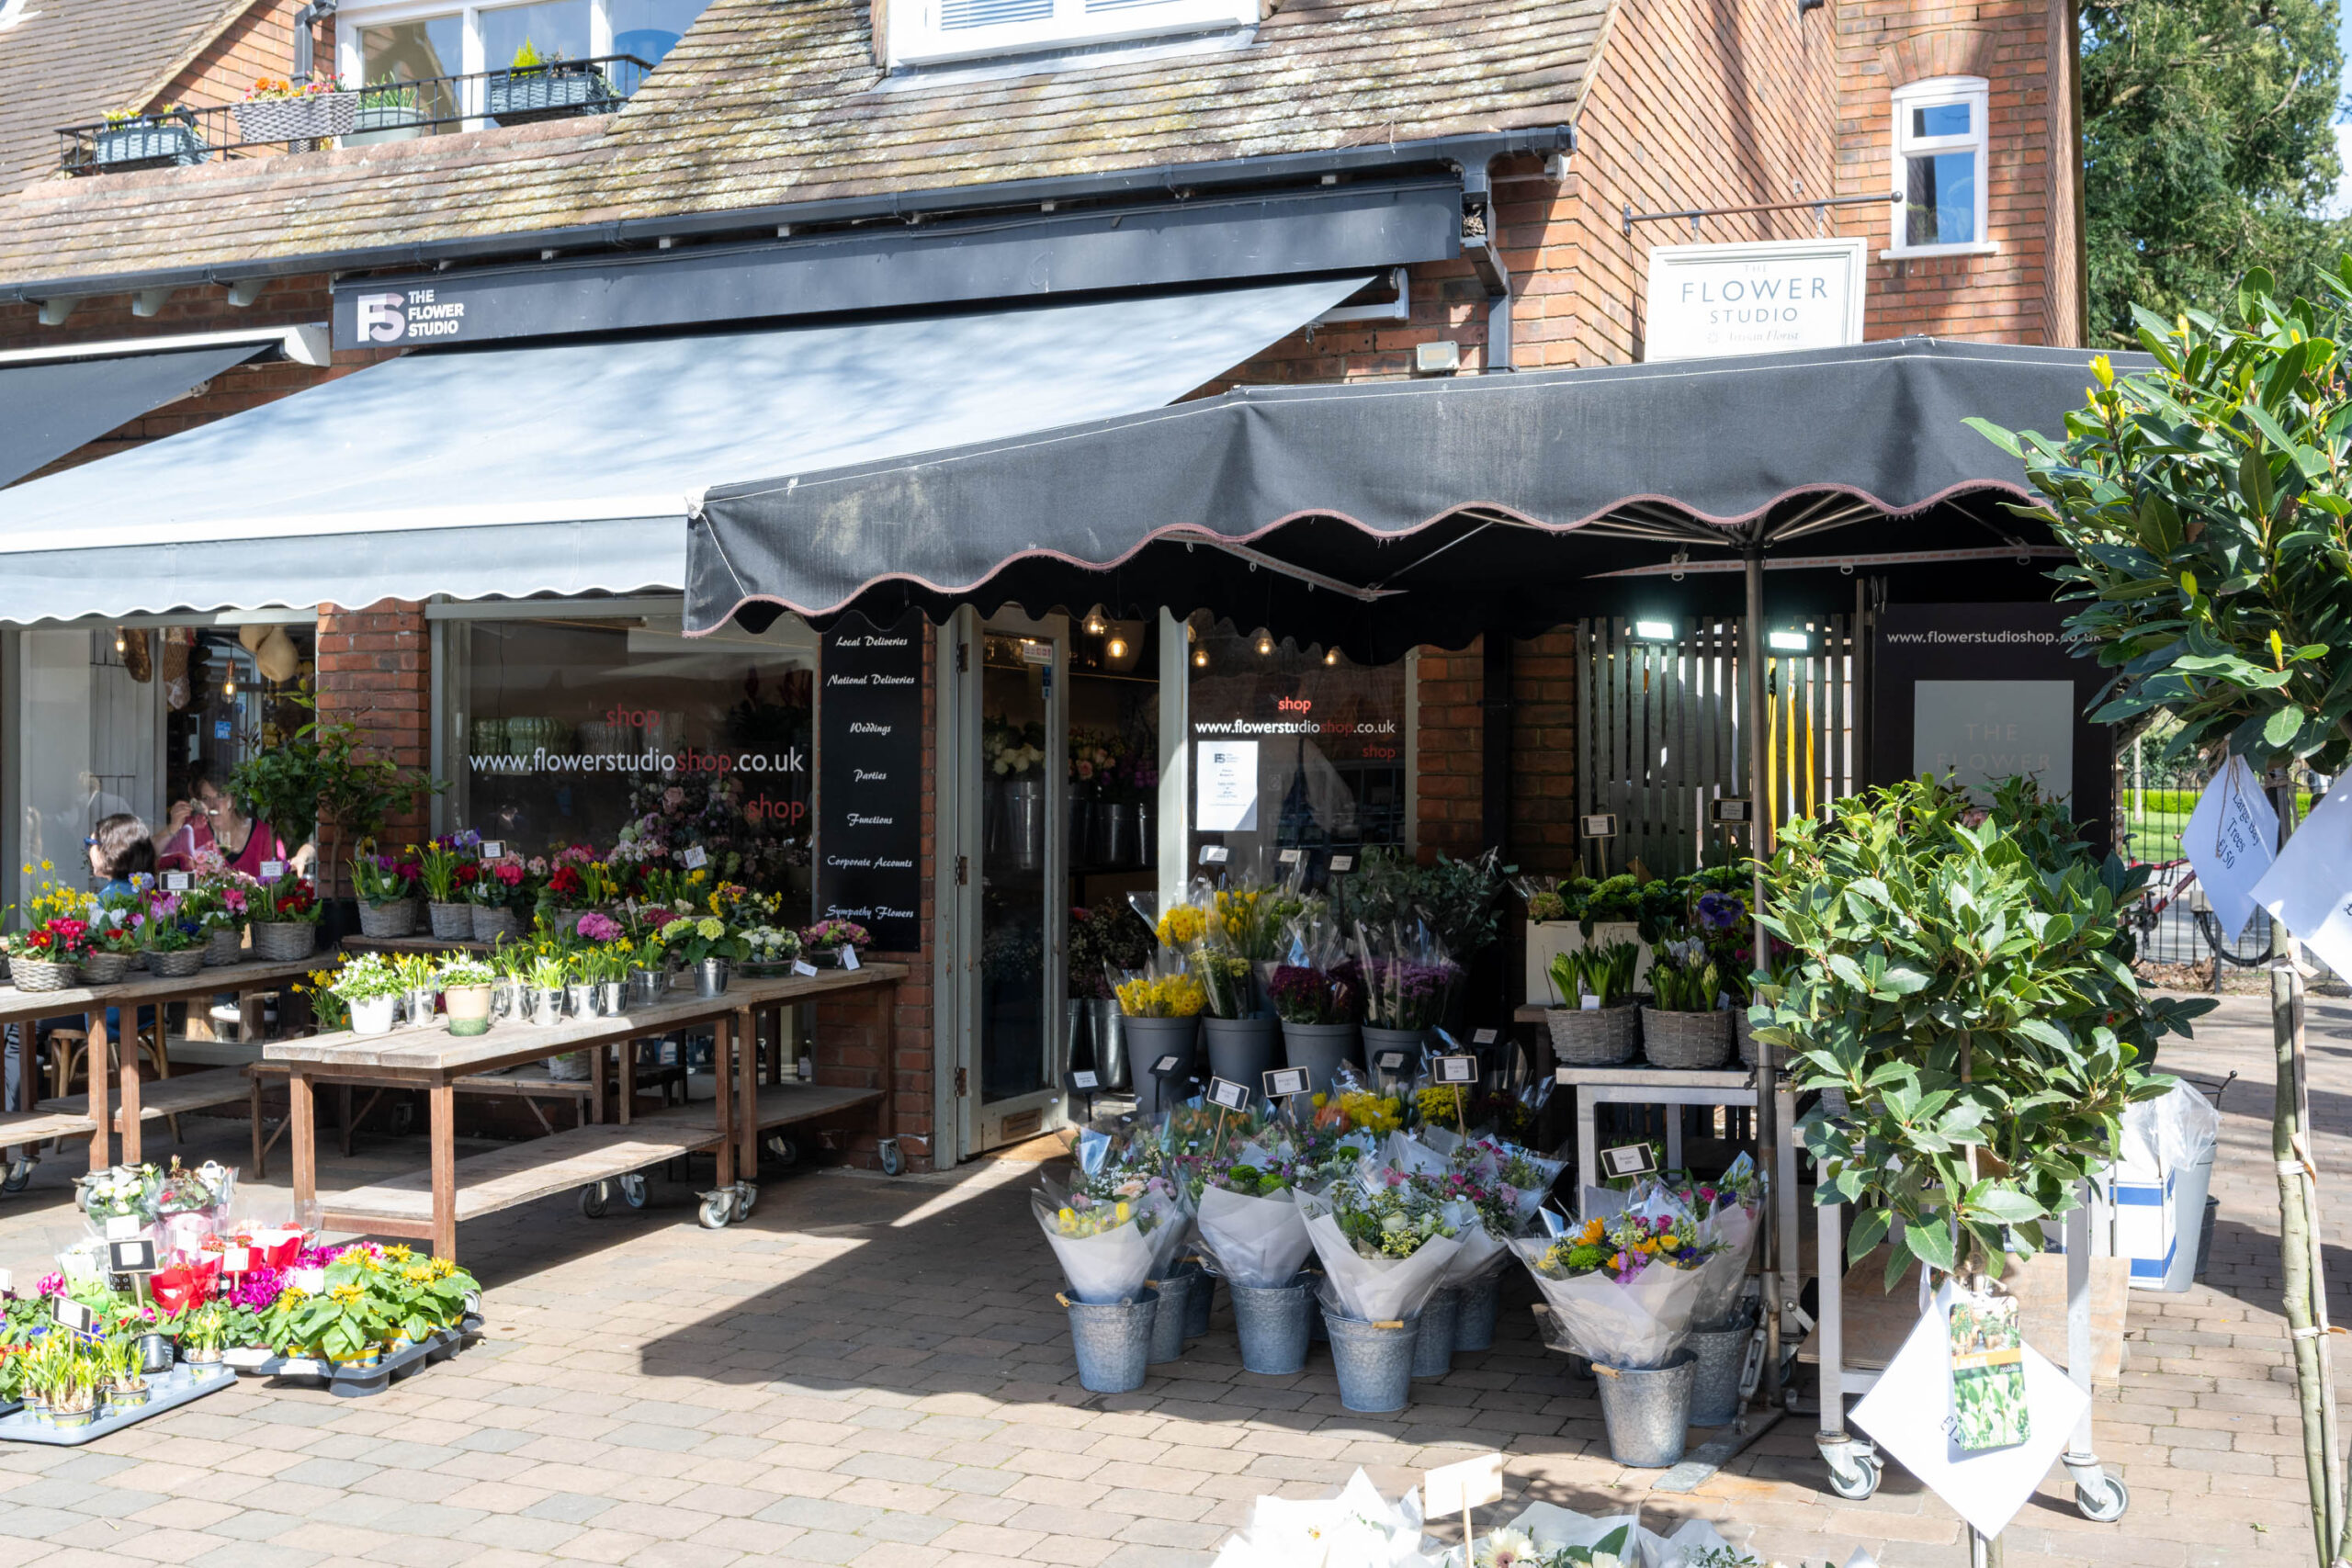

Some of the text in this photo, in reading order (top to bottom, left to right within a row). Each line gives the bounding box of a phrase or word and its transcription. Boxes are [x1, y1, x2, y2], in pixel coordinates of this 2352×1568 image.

[408, 289, 435, 304] THE
[1682, 277, 1827, 303] FLOWER
[408, 303, 465, 321] FLOWER
[1710, 308, 1798, 324] STUDIO
[408, 320, 458, 338] STUDIO
[835, 635, 908, 647] Local Deliveries
[827, 673, 915, 687] National Deliveries
[1278, 696, 1312, 715] shop
[605, 704, 661, 734] shop
[1194, 718, 1396, 738] www.flowerstudioshop.co.uk
[849, 722, 891, 736] Weddings
[1963, 723, 2018, 742] THE
[1362, 744, 1396, 762] shop
[469, 746, 804, 780] www.flowerstudioshop.co.uk
[853, 768, 888, 783] Parties
[747, 793, 805, 826] shop
[2233, 793, 2250, 824] Large
[846, 813, 893, 827] Functions
[2227, 818, 2246, 853] Trees
[827, 855, 913, 870] Corporate Accounts
[2217, 839, 2235, 870] £150
[825, 904, 914, 920] Sympathy Flowers
